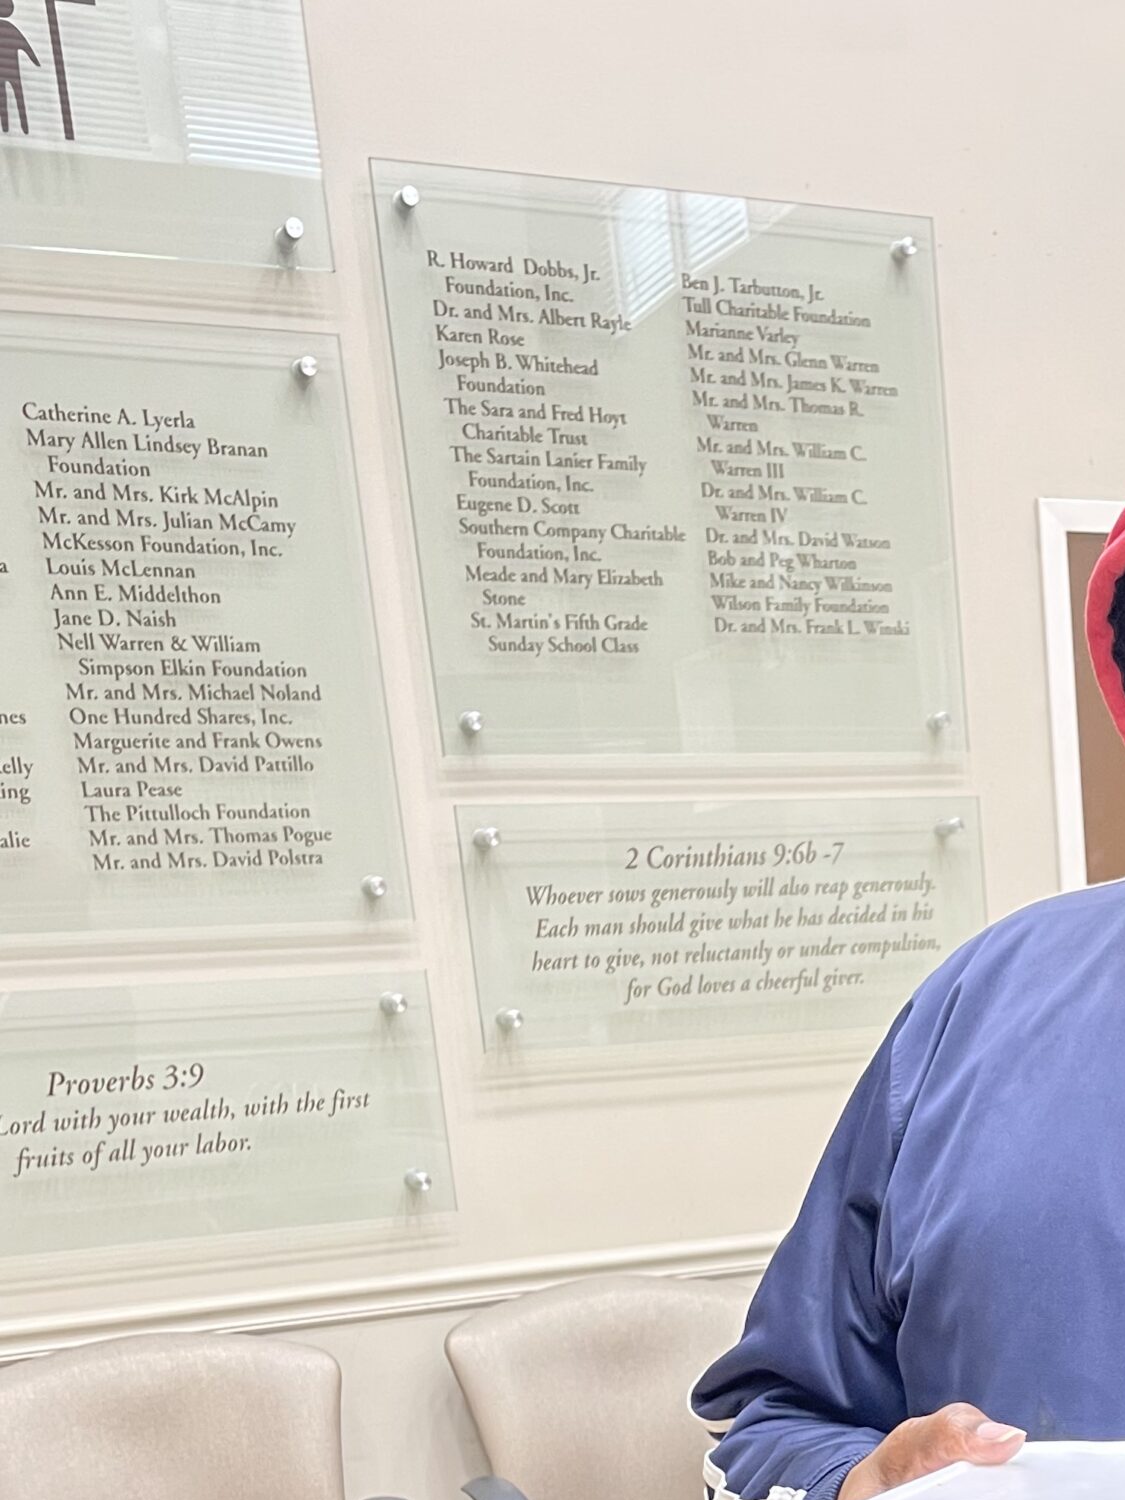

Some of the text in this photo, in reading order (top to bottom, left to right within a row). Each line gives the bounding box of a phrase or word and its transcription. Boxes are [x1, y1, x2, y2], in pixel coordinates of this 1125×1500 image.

[427, 250, 600, 284] R. Howard Dobbs, Jr.
[445, 276, 574, 302] Foundation, Inc.
[682, 273, 709, 291] Ben
[681, 296, 871, 327] Tull Charitable Foundation
[436, 324, 524, 346] Karen Rose
[438, 349, 598, 376] Joseph B. Whitehead
[457, 374, 546, 396] Foundation
[22, 402, 195, 432] Catherine A. Lyerla
[26, 428, 268, 459] Mary Allen Lindsey Branan
[48, 455, 150, 477] Foundation
[34, 480, 278, 512] Mr. and Mrs. Kirk McAlpin
[457, 494, 580, 516] Eugene D. Scott
[459, 517, 686, 544] Southern Company Charitable
[42, 532, 282, 557] McKesson Foundation, Inc.
[477, 542, 602, 562] Foundation, Inc.
[46, 557, 195, 578] Louis McLennan
[708, 550, 856, 573] Bob and Peg Wharton
[51, 584, 220, 603] Ann E. Middelthon
[54, 608, 176, 630] Jane D. Naish
[471, 612, 648, 631] St. Martin's Fifth Grade
[57, 632, 260, 652] Nell Warren & William
[488, 635, 639, 657] Sunday School Class
[70, 707, 292, 726] One Hundred Shares, Inc.
[81, 781, 182, 798] Laura Pease
[84, 802, 310, 822] The Pittulloch Foundation
[625, 847, 638, 869] 2
[647, 843, 766, 869] Corinthians
[773, 840, 816, 866] 9:6b
[526, 872, 935, 908] Whoever sows generously will also reap generously.
[536, 902, 933, 938] Each man should give what he has decided in his
[532, 932, 940, 974] heart to give, not reluctantly or under compulsion,
[624, 968, 864, 1005] for God loves a cheerful giver.
[48, 1063, 204, 1096] Proverbs 3:9
[54, 1107, 101, 1132] with
[107, 1111, 156, 1135] your
[164, 1097, 235, 1123] wealth,
[245, 1093, 288, 1117] with
[297, 1091, 326, 1116] the
[329, 1088, 368, 1117] first
[13, 1131, 250, 1177] fruits of all your labor.
